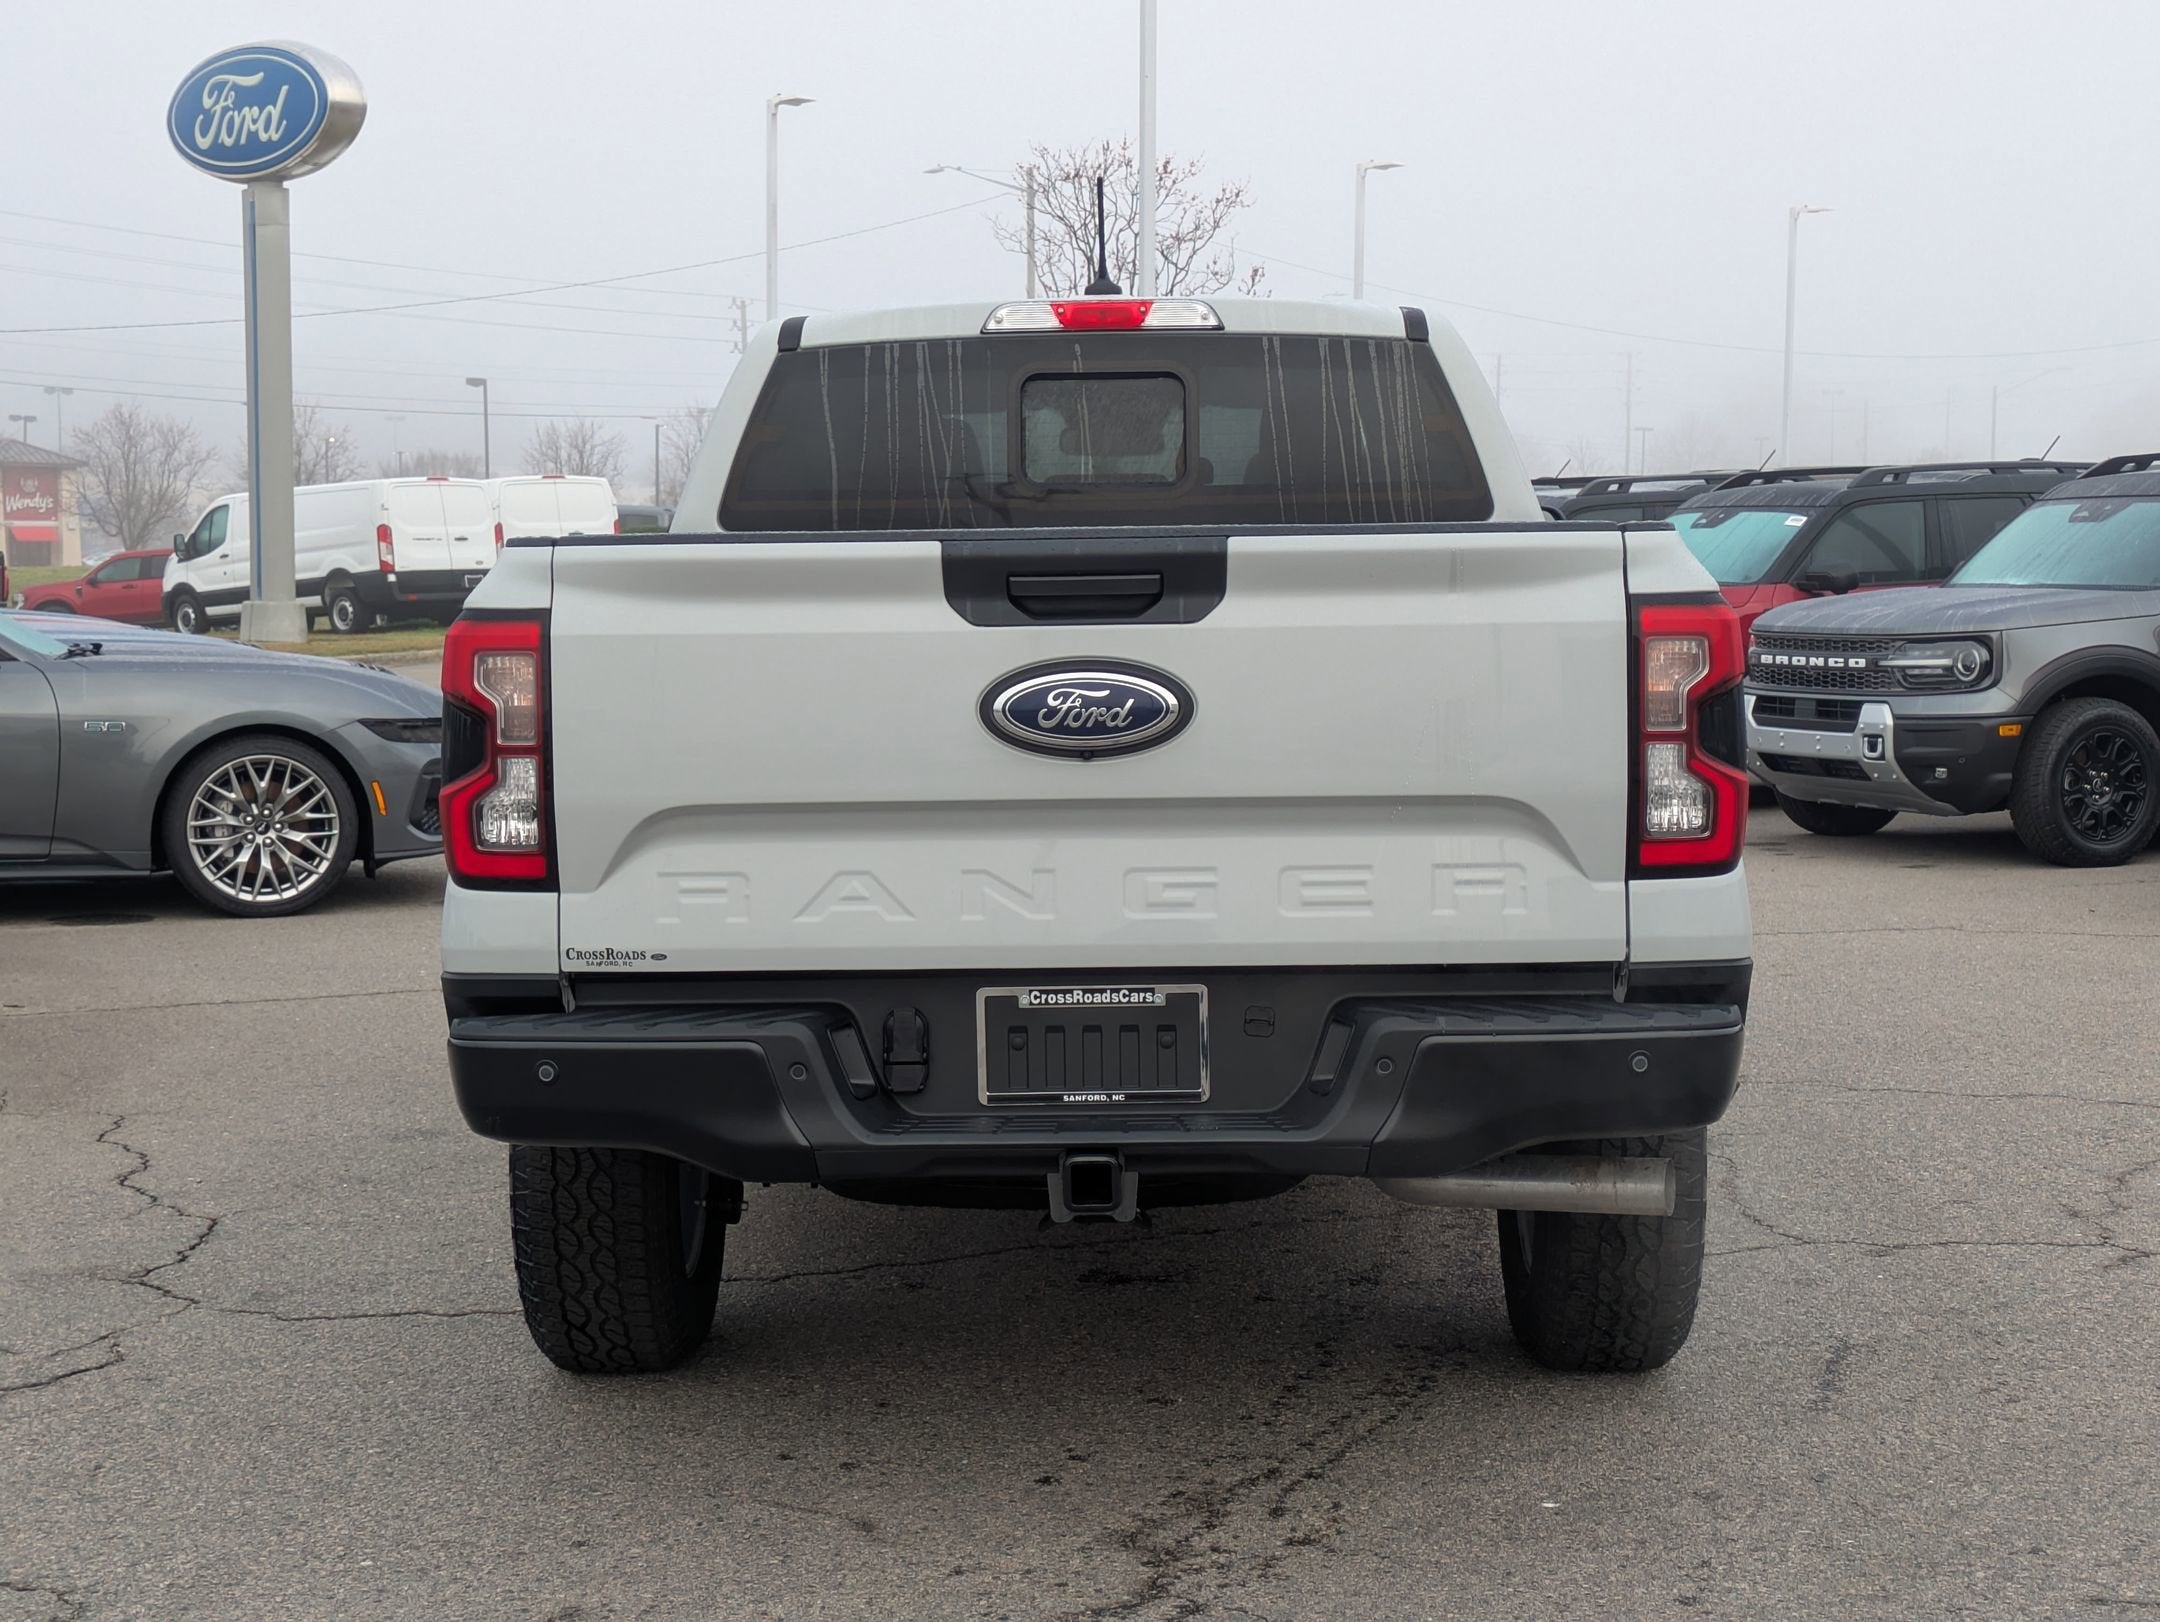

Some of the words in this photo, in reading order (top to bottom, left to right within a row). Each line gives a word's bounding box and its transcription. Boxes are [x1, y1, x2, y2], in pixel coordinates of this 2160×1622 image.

[194, 71, 290, 151] Ford
[6, 492, 54, 513] Wendy's
[1760, 654, 1866, 668] BRONCO
[1037, 687, 1136, 729] Ford
[654, 862, 1530, 925] RANGER
[1030, 990, 1154, 1005] CrossRoadsCars
[1063, 1094, 1110, 1102] SANFORD,
